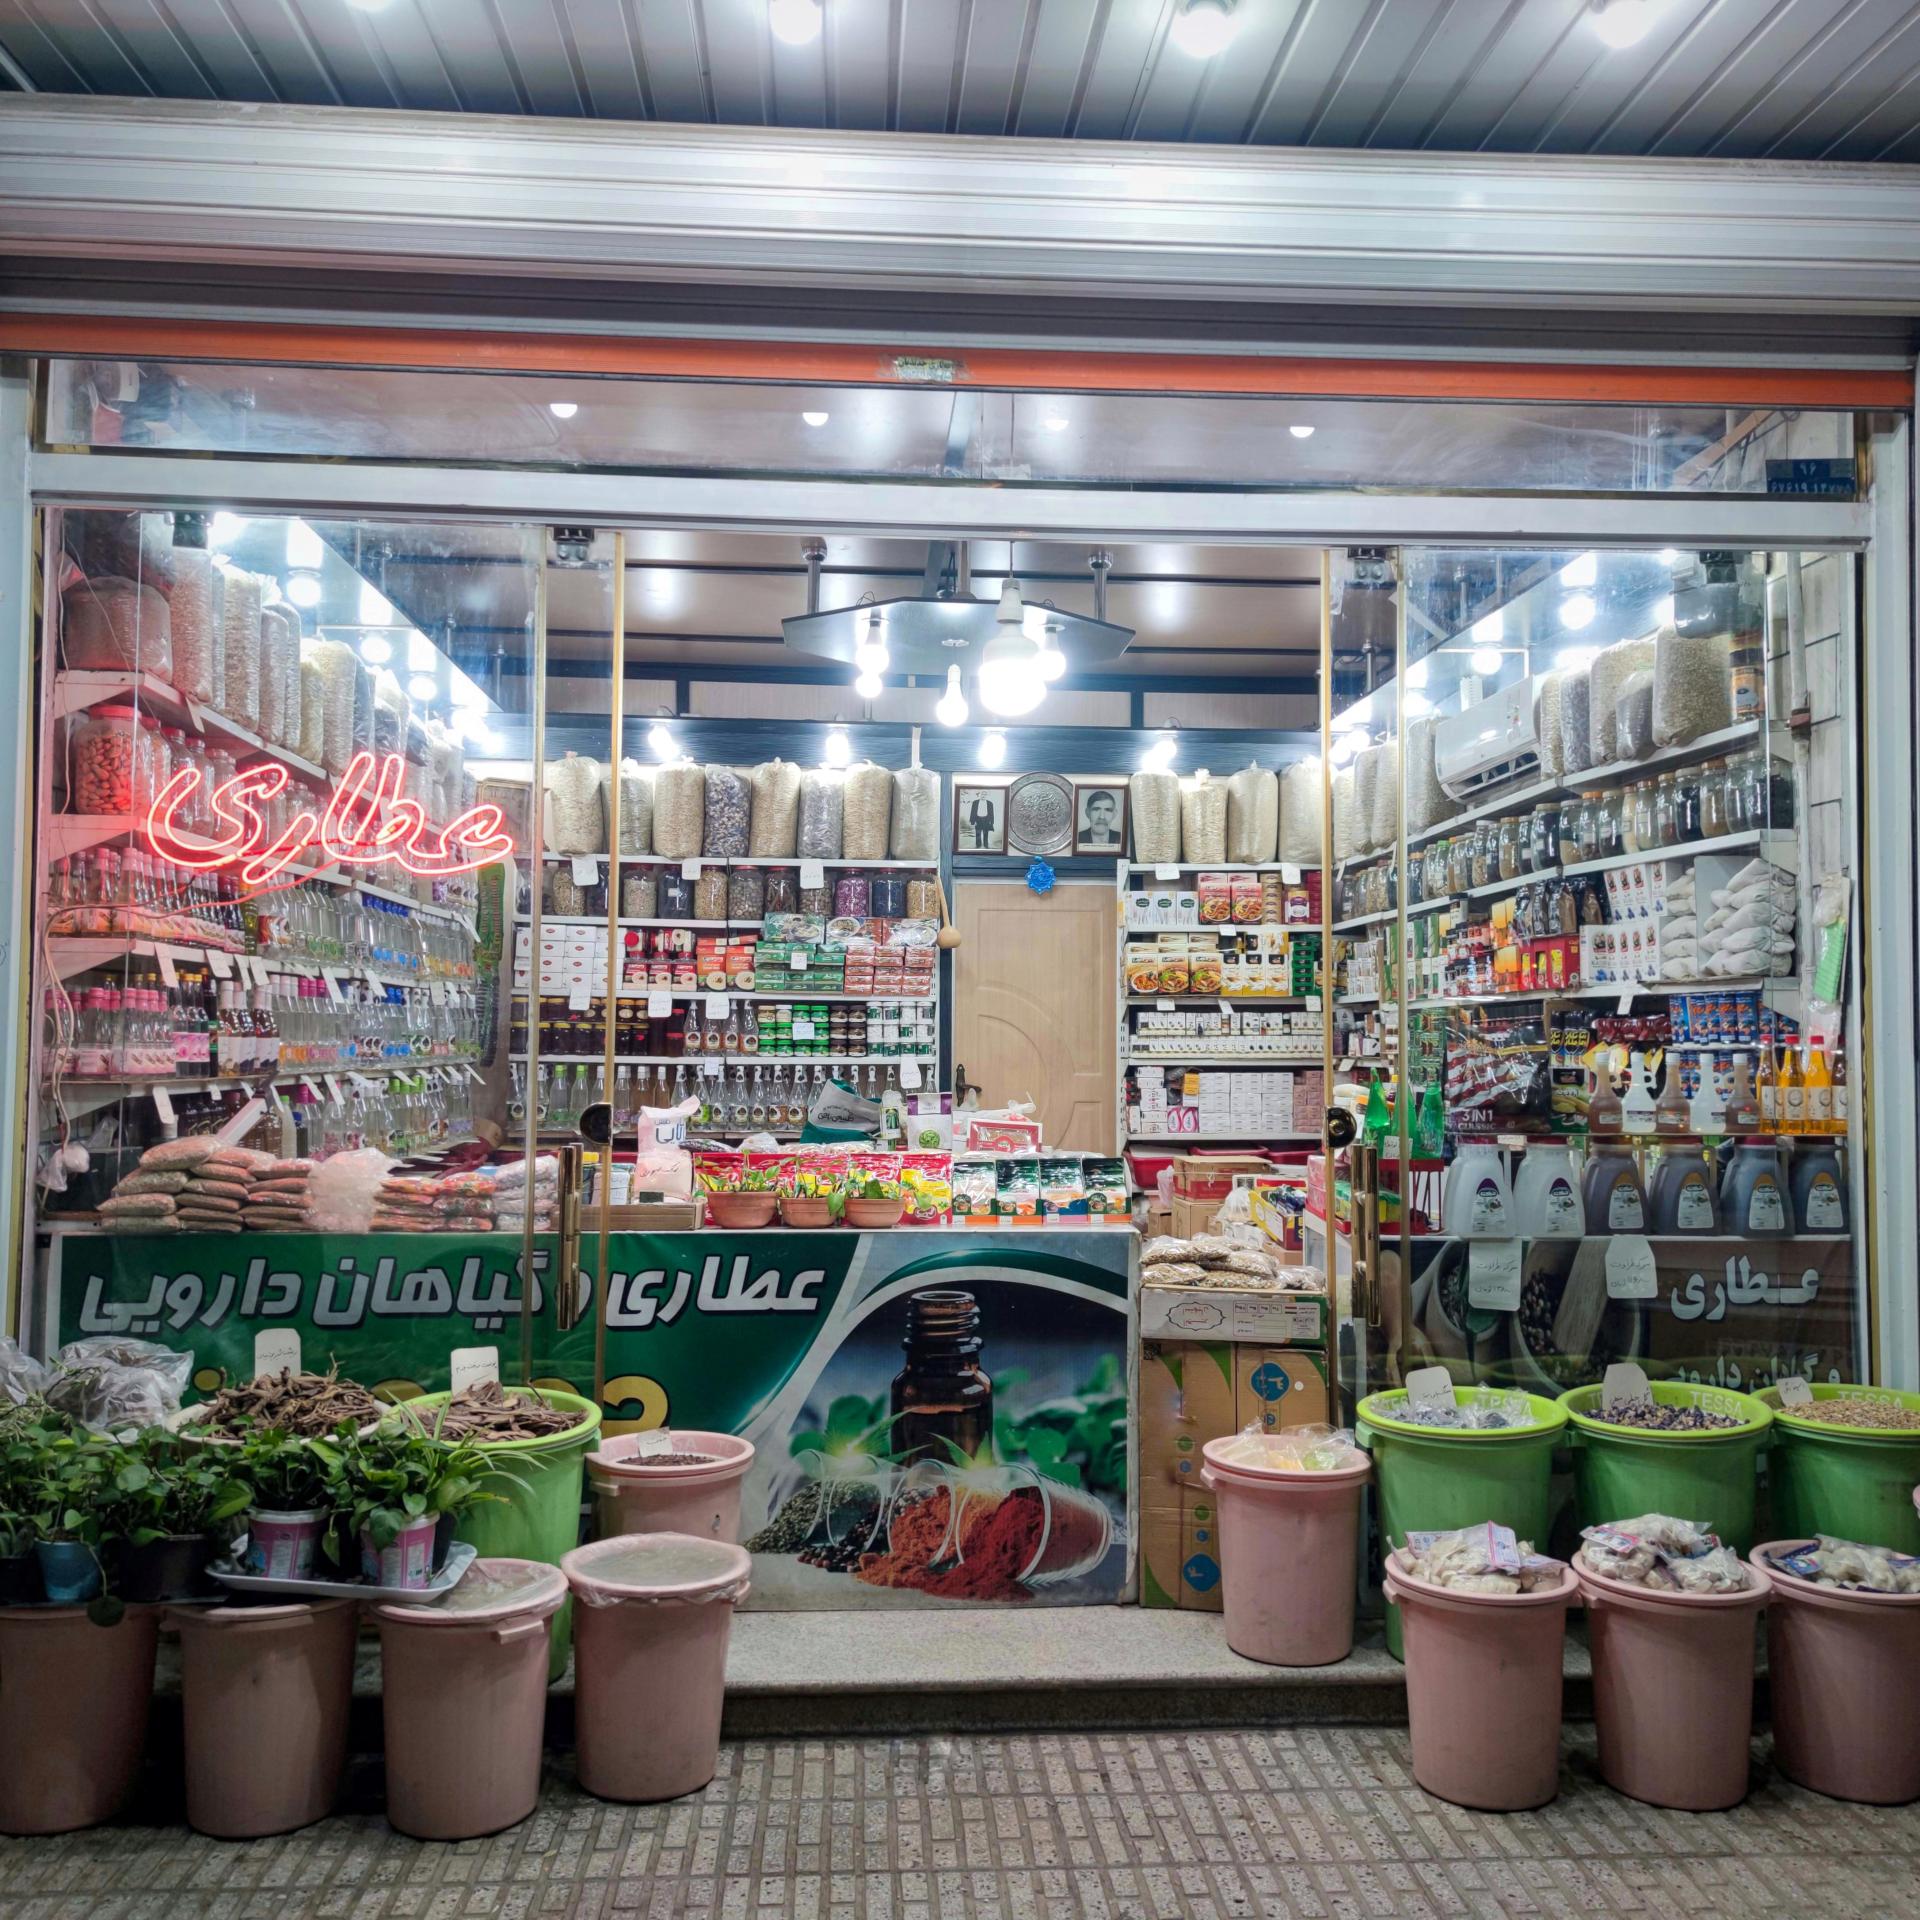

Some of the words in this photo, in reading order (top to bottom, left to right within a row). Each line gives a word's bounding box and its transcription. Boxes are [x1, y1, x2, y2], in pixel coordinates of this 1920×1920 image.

[147, 751, 513, 884] عطاری
[79, 1257, 303, 1333] دارویی
[313, 1250, 550, 1330] گیاهان
[605, 1255, 826, 1328] عطاری
[1670, 1256, 1820, 1321] عطاری
[1689, 1391, 1744, 1420] TESSA
